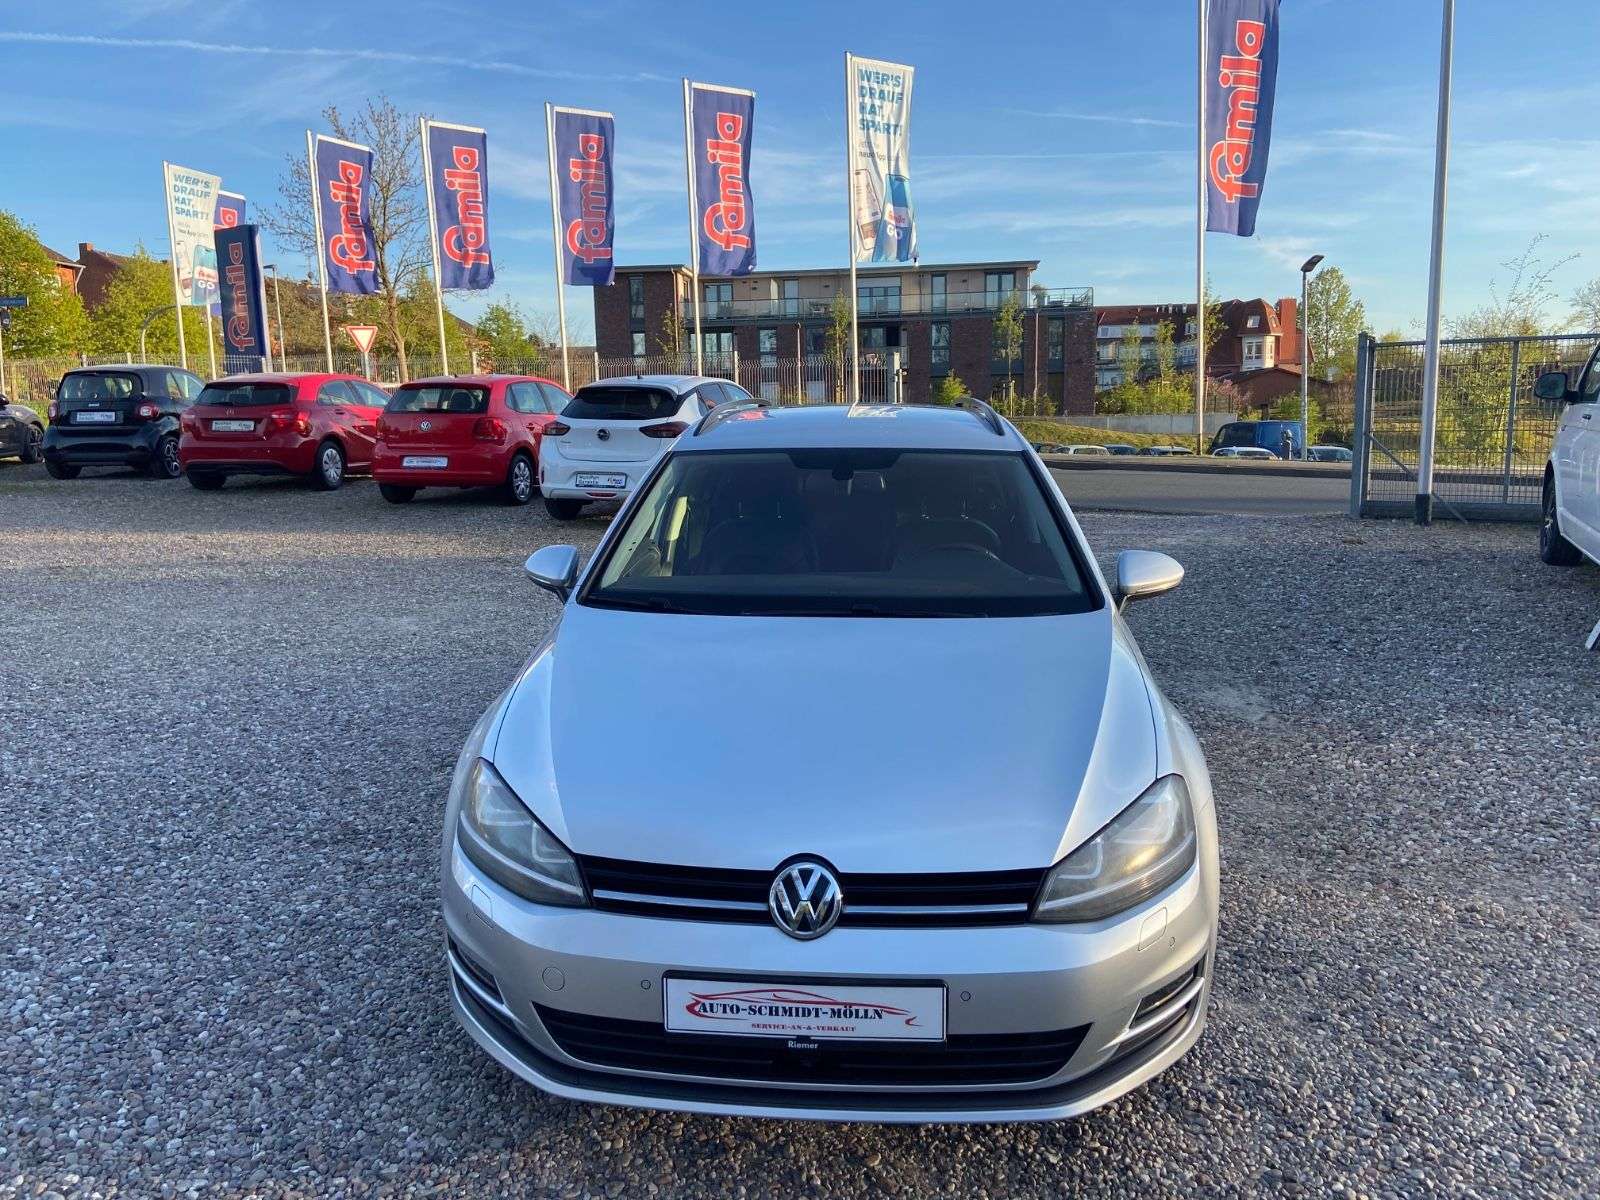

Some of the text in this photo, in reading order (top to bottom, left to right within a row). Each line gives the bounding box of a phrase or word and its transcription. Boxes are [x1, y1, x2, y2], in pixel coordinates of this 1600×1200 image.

[859, 68, 902, 88] WER'S
[859, 84, 903, 104] DRAUF
[1210, 20, 1266, 203] famila
[859, 117, 903, 137] SPART!
[173, 173, 212, 190] WER'S
[173, 183, 212, 199] DRAUF
[704, 112, 752, 251] famila
[443, 145, 490, 268] famila
[567, 133, 612, 264] famila
[175, 206, 210, 221] SPART!
[329, 159, 375, 275] famila
[227, 242, 255, 352] famila
[698, 1002, 885, 1020] AUTO-SCHMIDT-MÖLLN
[788, 1040, 818, 1049] Riemer
